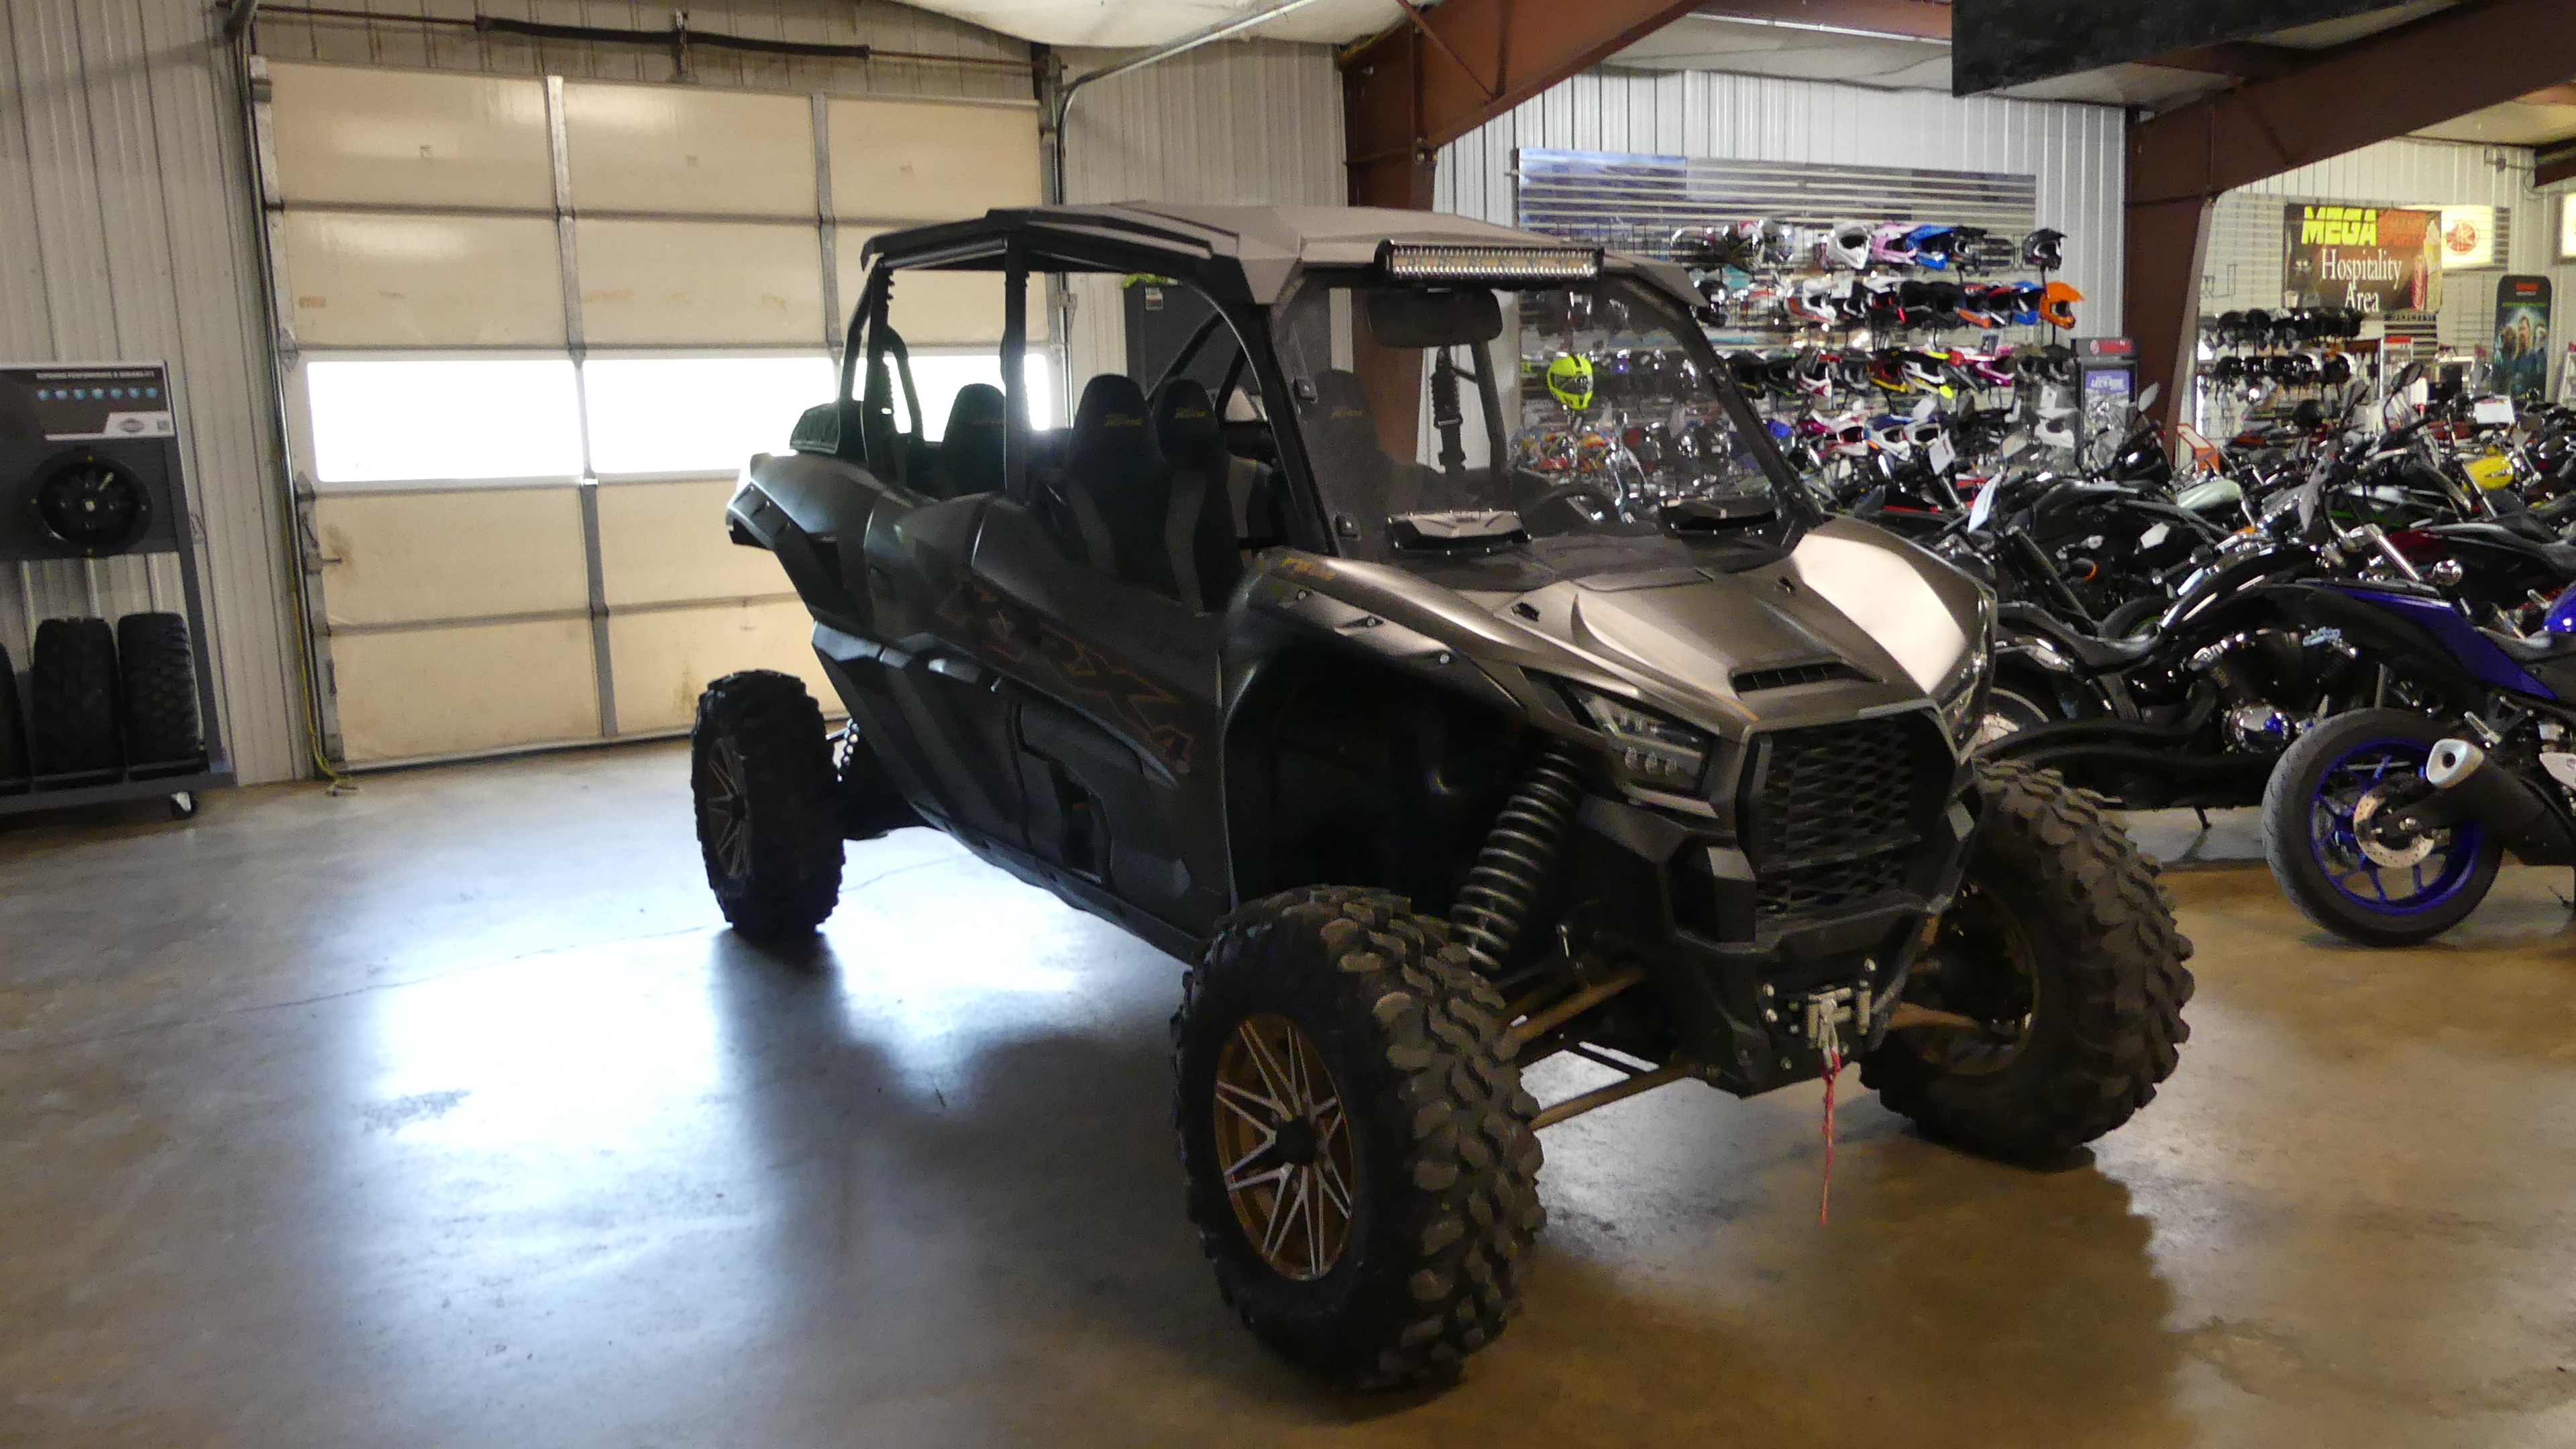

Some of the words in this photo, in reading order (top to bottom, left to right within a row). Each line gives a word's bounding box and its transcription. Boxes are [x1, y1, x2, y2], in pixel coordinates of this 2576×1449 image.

[2301, 205, 2377, 247] MEGA
[2321, 248, 2402, 290] Hospitality
[2345, 282, 2380, 313] Area
